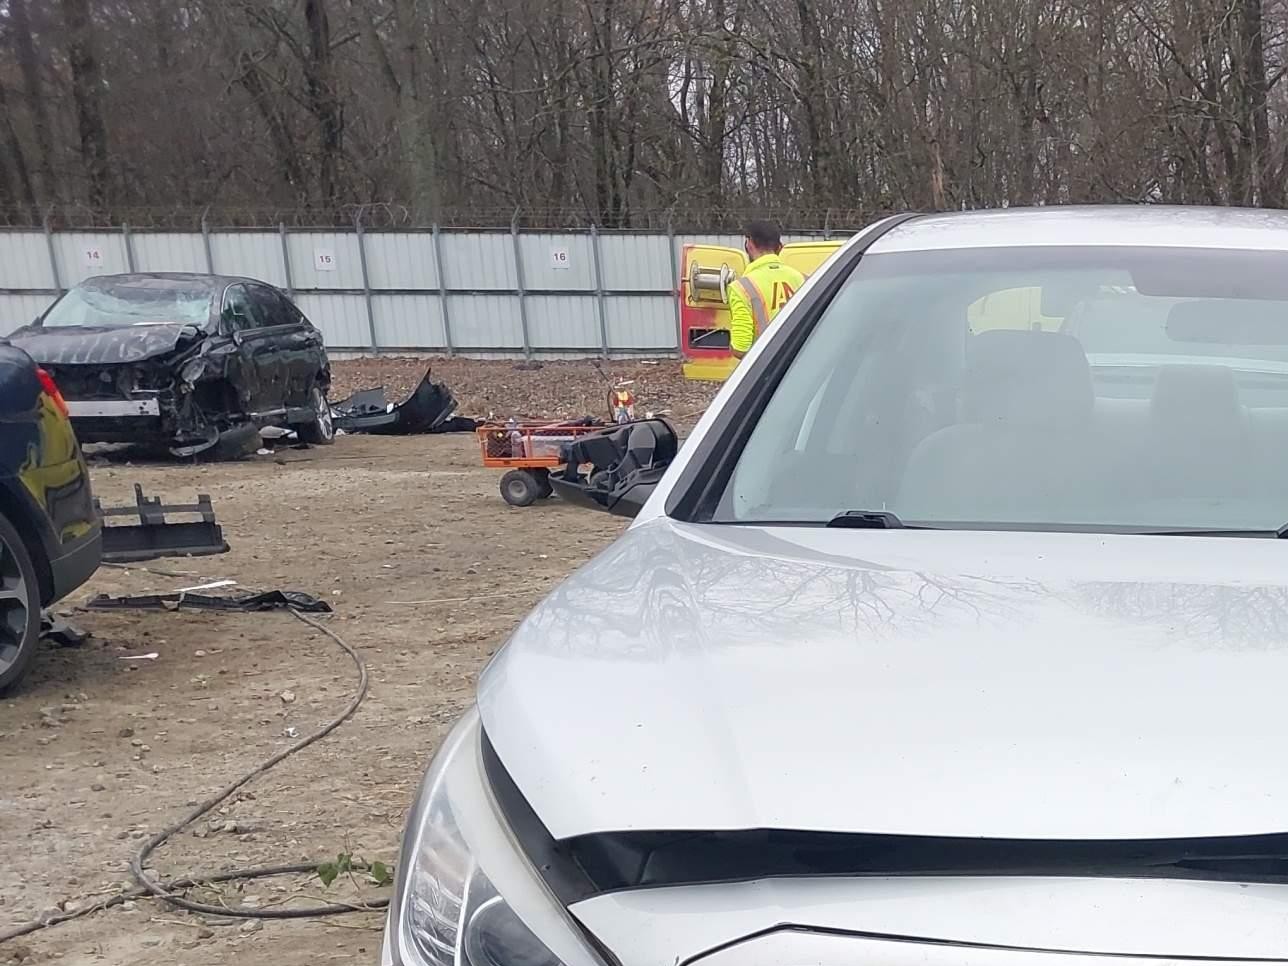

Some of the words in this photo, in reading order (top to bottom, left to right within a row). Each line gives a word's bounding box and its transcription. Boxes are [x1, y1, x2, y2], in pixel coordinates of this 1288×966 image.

[87, 250, 100, 260] 14
[319, 255, 332, 264] 15
[554, 252, 567, 262] 16
